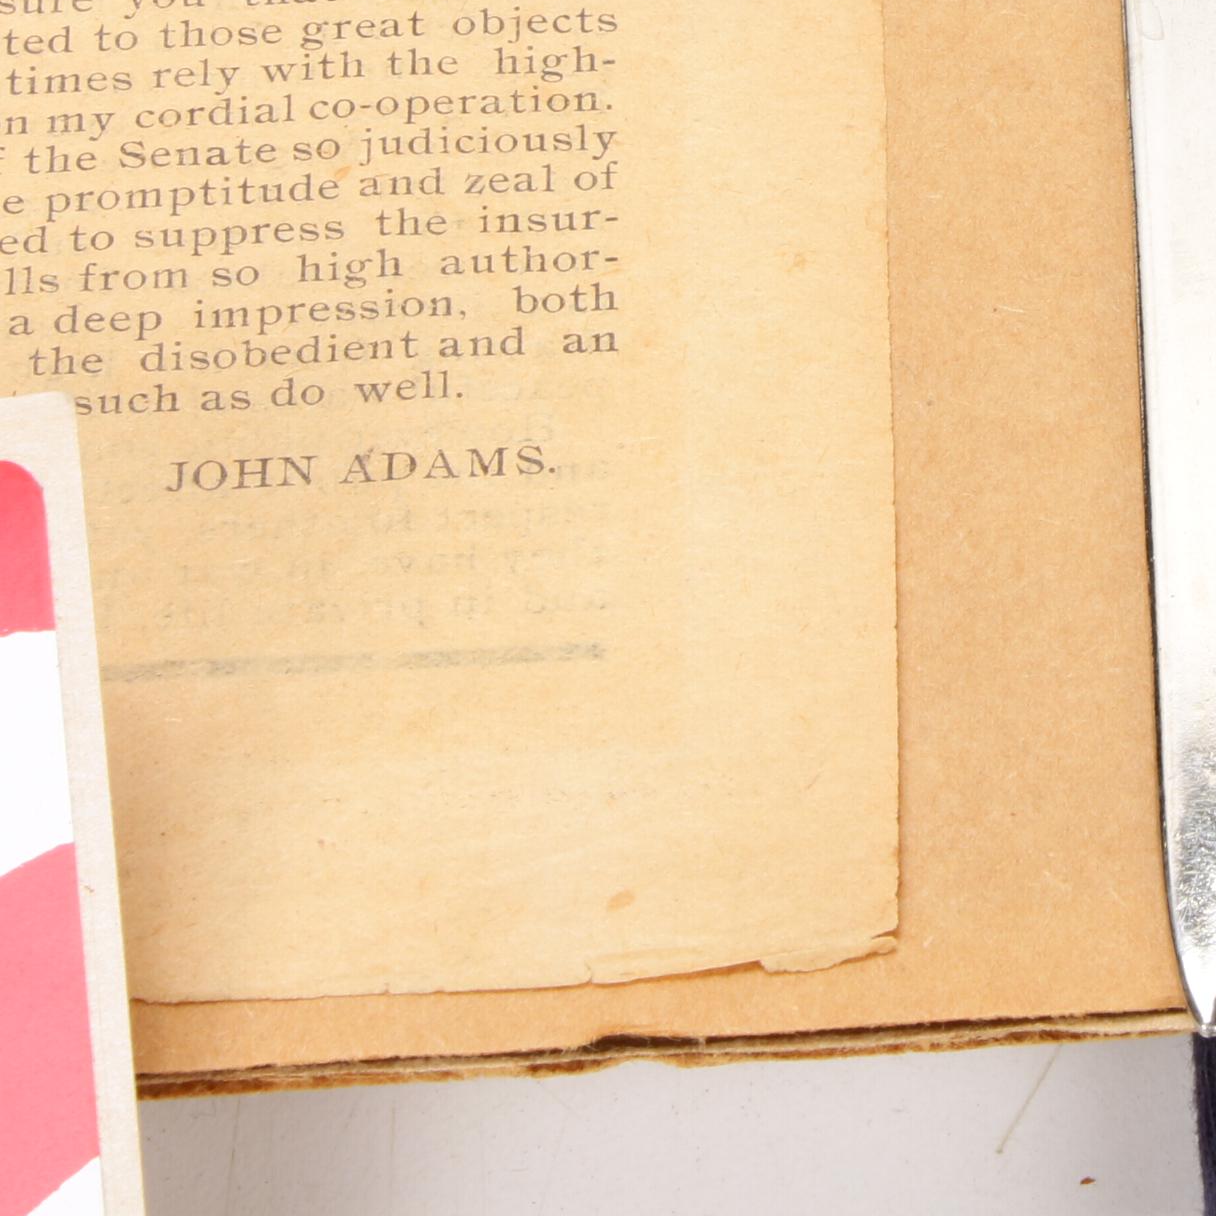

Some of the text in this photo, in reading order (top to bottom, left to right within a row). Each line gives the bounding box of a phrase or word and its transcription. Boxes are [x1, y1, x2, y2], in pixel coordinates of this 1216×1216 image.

[93, 6, 618, 52] to those great objects
[5, 45, 616, 96] times rely with the high-
[47, 84, 613, 142] my cordial co-operation.
[23, 123, 618, 175] the Senate so judiciously
[45, 160, 619, 223] promptitude and zeal of
[69, 205, 619, 257] to suppress the insur-
[79, 245, 619, 292] from so high author-
[8, 281, 619, 342] a deep impression, both
[28, 325, 620, 377] the disobedient and an
[74, 369, 464, 416] such as do well.
[165, 445, 556, 493] JOHN ADAMS.
